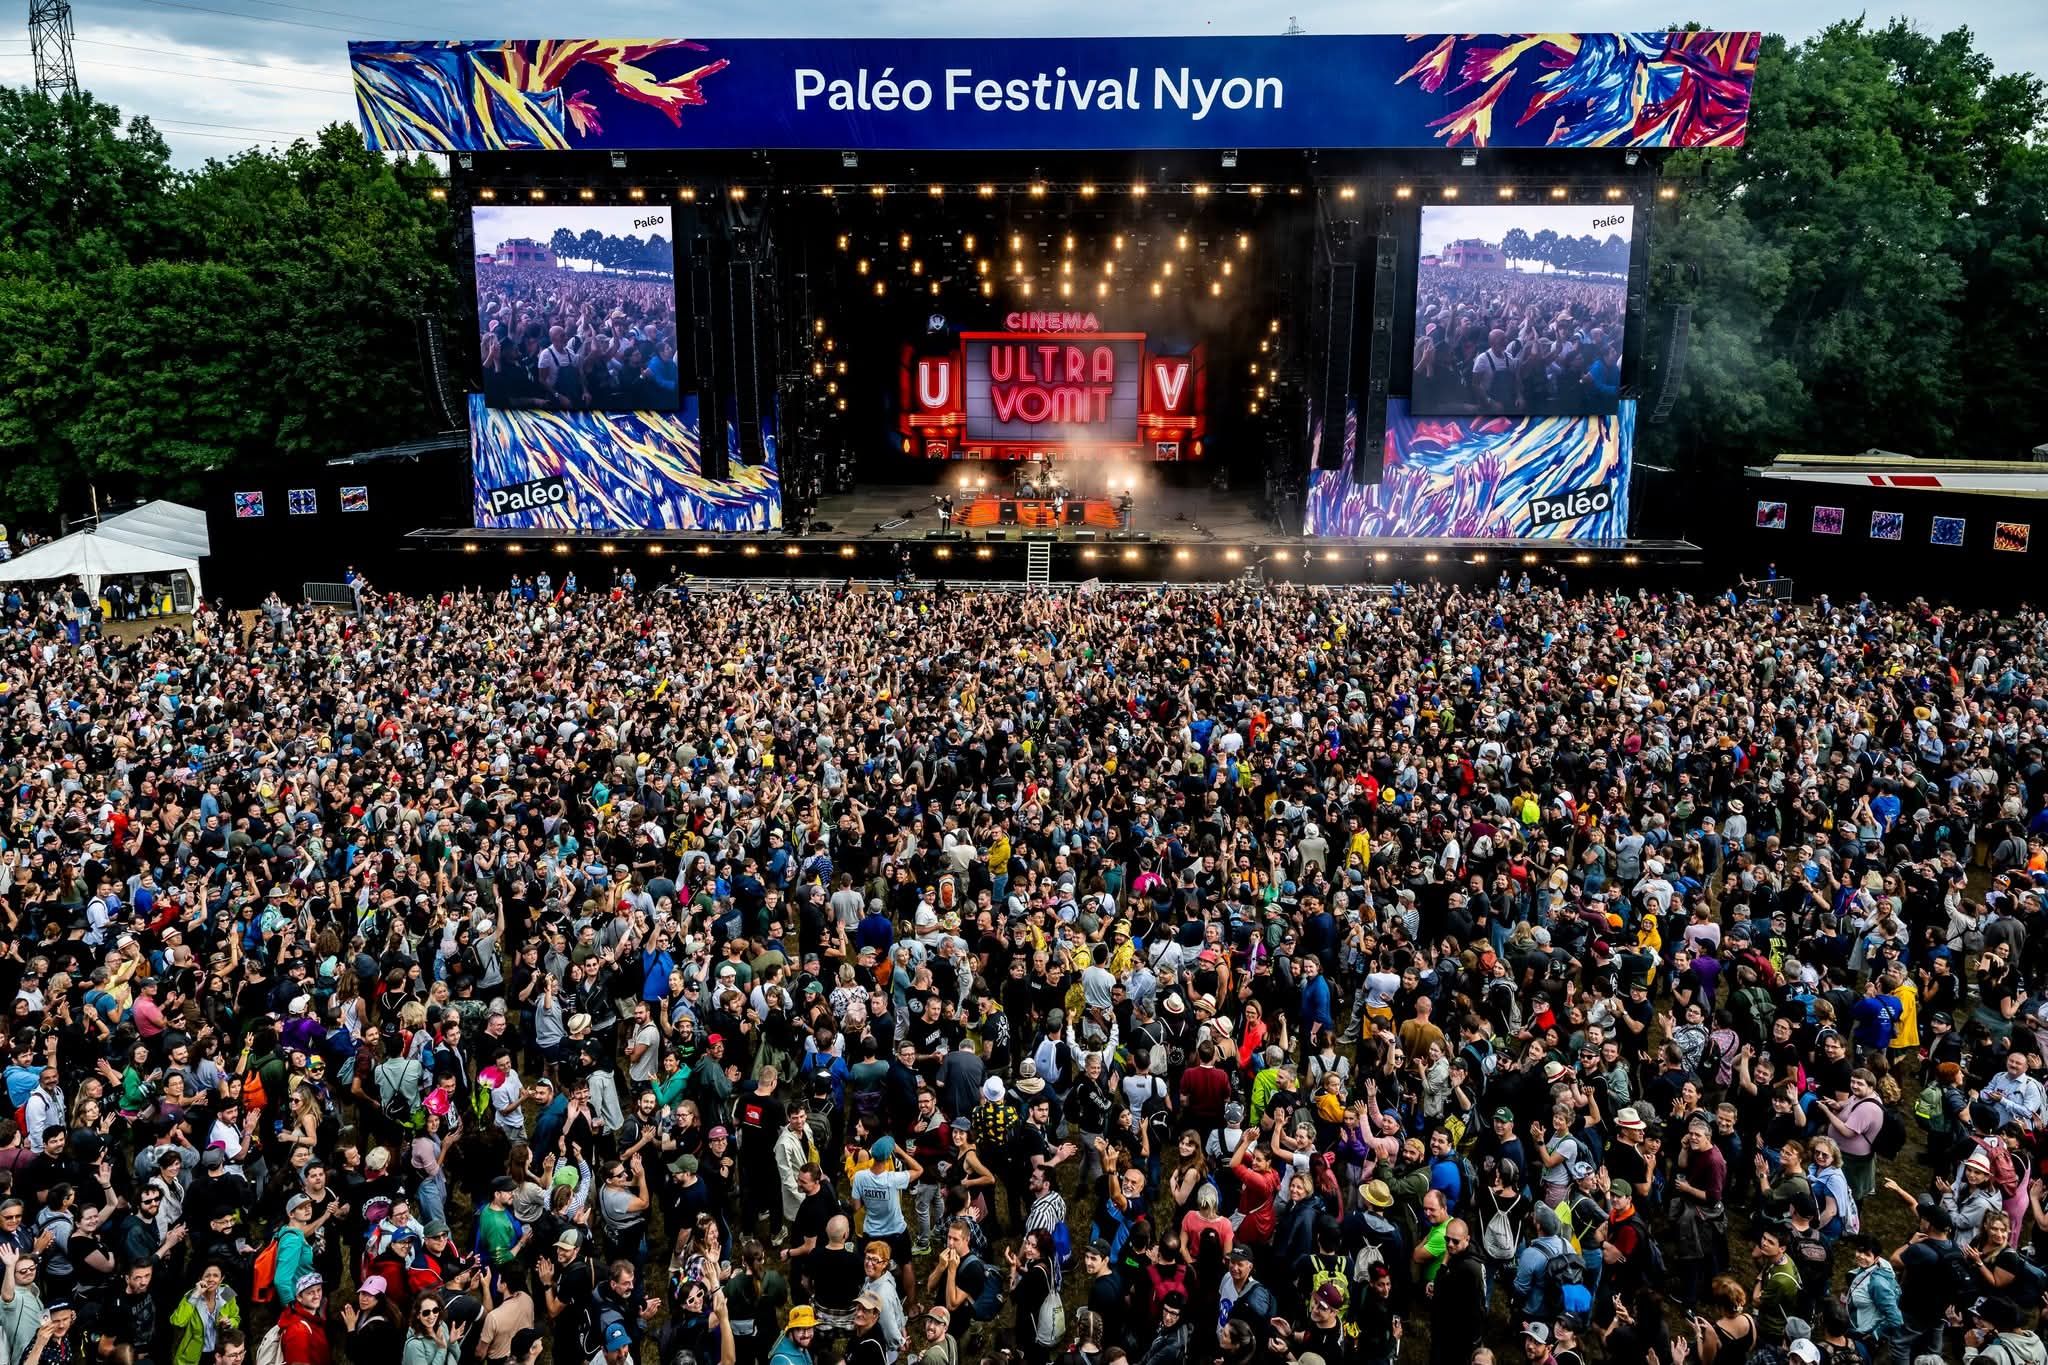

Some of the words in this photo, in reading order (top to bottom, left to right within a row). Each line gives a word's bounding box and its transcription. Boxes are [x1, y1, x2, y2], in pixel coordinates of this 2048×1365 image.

[795, 68, 932, 111] Paléo
[946, 67, 1139, 112] Festival
[1154, 67, 1283, 121] Nyon
[634, 215, 664, 229] Paléo
[1592, 215, 1625, 229] Paléo
[1006, 311, 1099, 329] CINEMA
[991, 346, 1113, 382] ULTRA
[919, 362, 949, 408] U
[1155, 363, 1189, 411] V
[991, 386, 1113, 423] VOMIT
[491, 482, 564, 513] Paléo
[1532, 491, 1609, 524] Paléo
